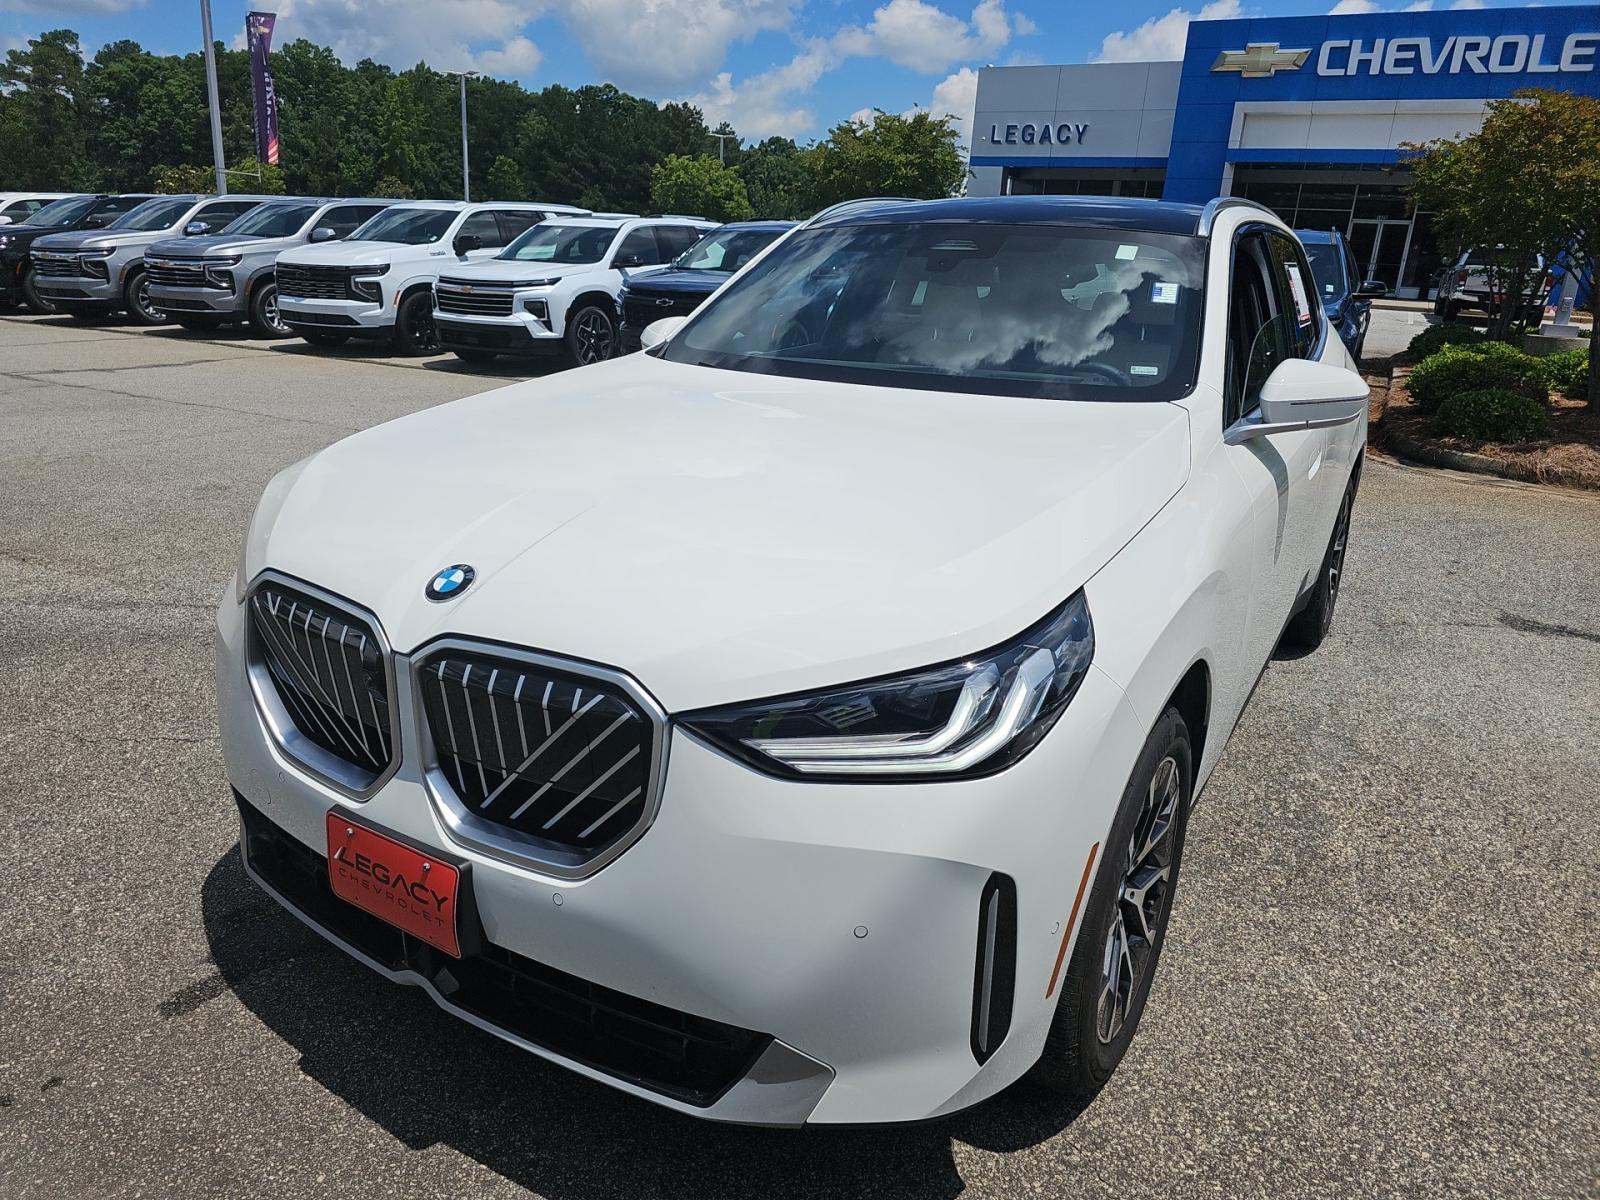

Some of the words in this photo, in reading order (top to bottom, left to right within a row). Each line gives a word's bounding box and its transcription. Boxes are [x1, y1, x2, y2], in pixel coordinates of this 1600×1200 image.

[990, 124, 1090, 145] LEGACY
[335, 846, 448, 912] LEGACY
[338, 867, 444, 928] CHEVROLET
